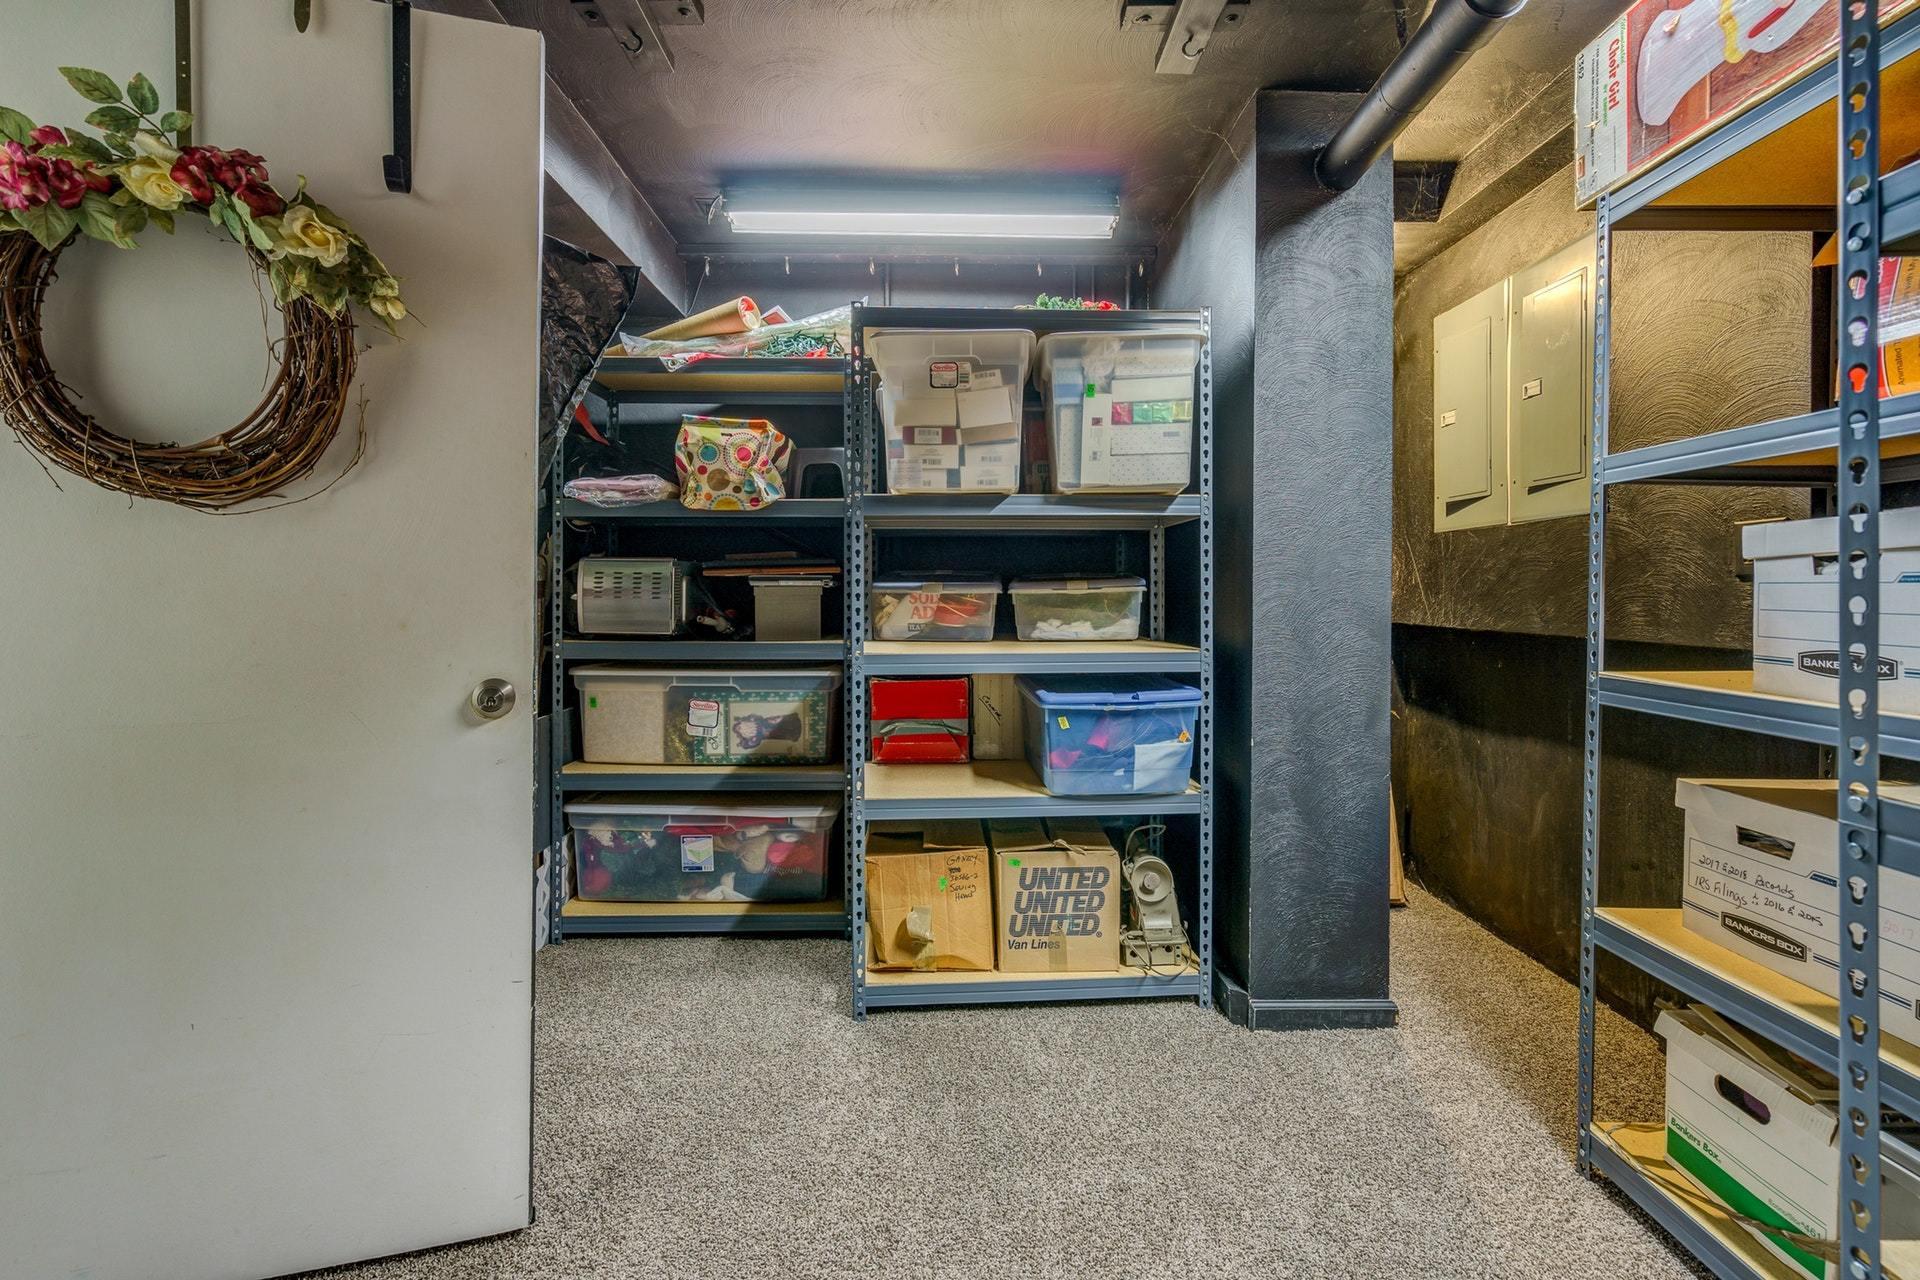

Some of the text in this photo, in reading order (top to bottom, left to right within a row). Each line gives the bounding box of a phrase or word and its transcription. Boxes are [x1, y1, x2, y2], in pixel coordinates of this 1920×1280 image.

[1608, 37, 1621, 111] Choir Girl
[1894, 348, 1905, 386] Animated
[1019, 866, 1110, 890] UNITED
[1694, 875, 1710, 891] IRS
[1713, 882, 1748, 910] Filings
[1764, 898, 1785, 913] 2016
[1699, 854, 1720, 872] 2017
[1754, 874, 1795, 900] Records
[1014, 890, 1105, 914] UNITED
[1008, 914, 1100, 938] UNITED
[1724, 917, 1803, 957] BANKERS BOX
[1008, 938, 1061, 951] Van Lines
[1670, 1117, 1701, 1147] Bankers
